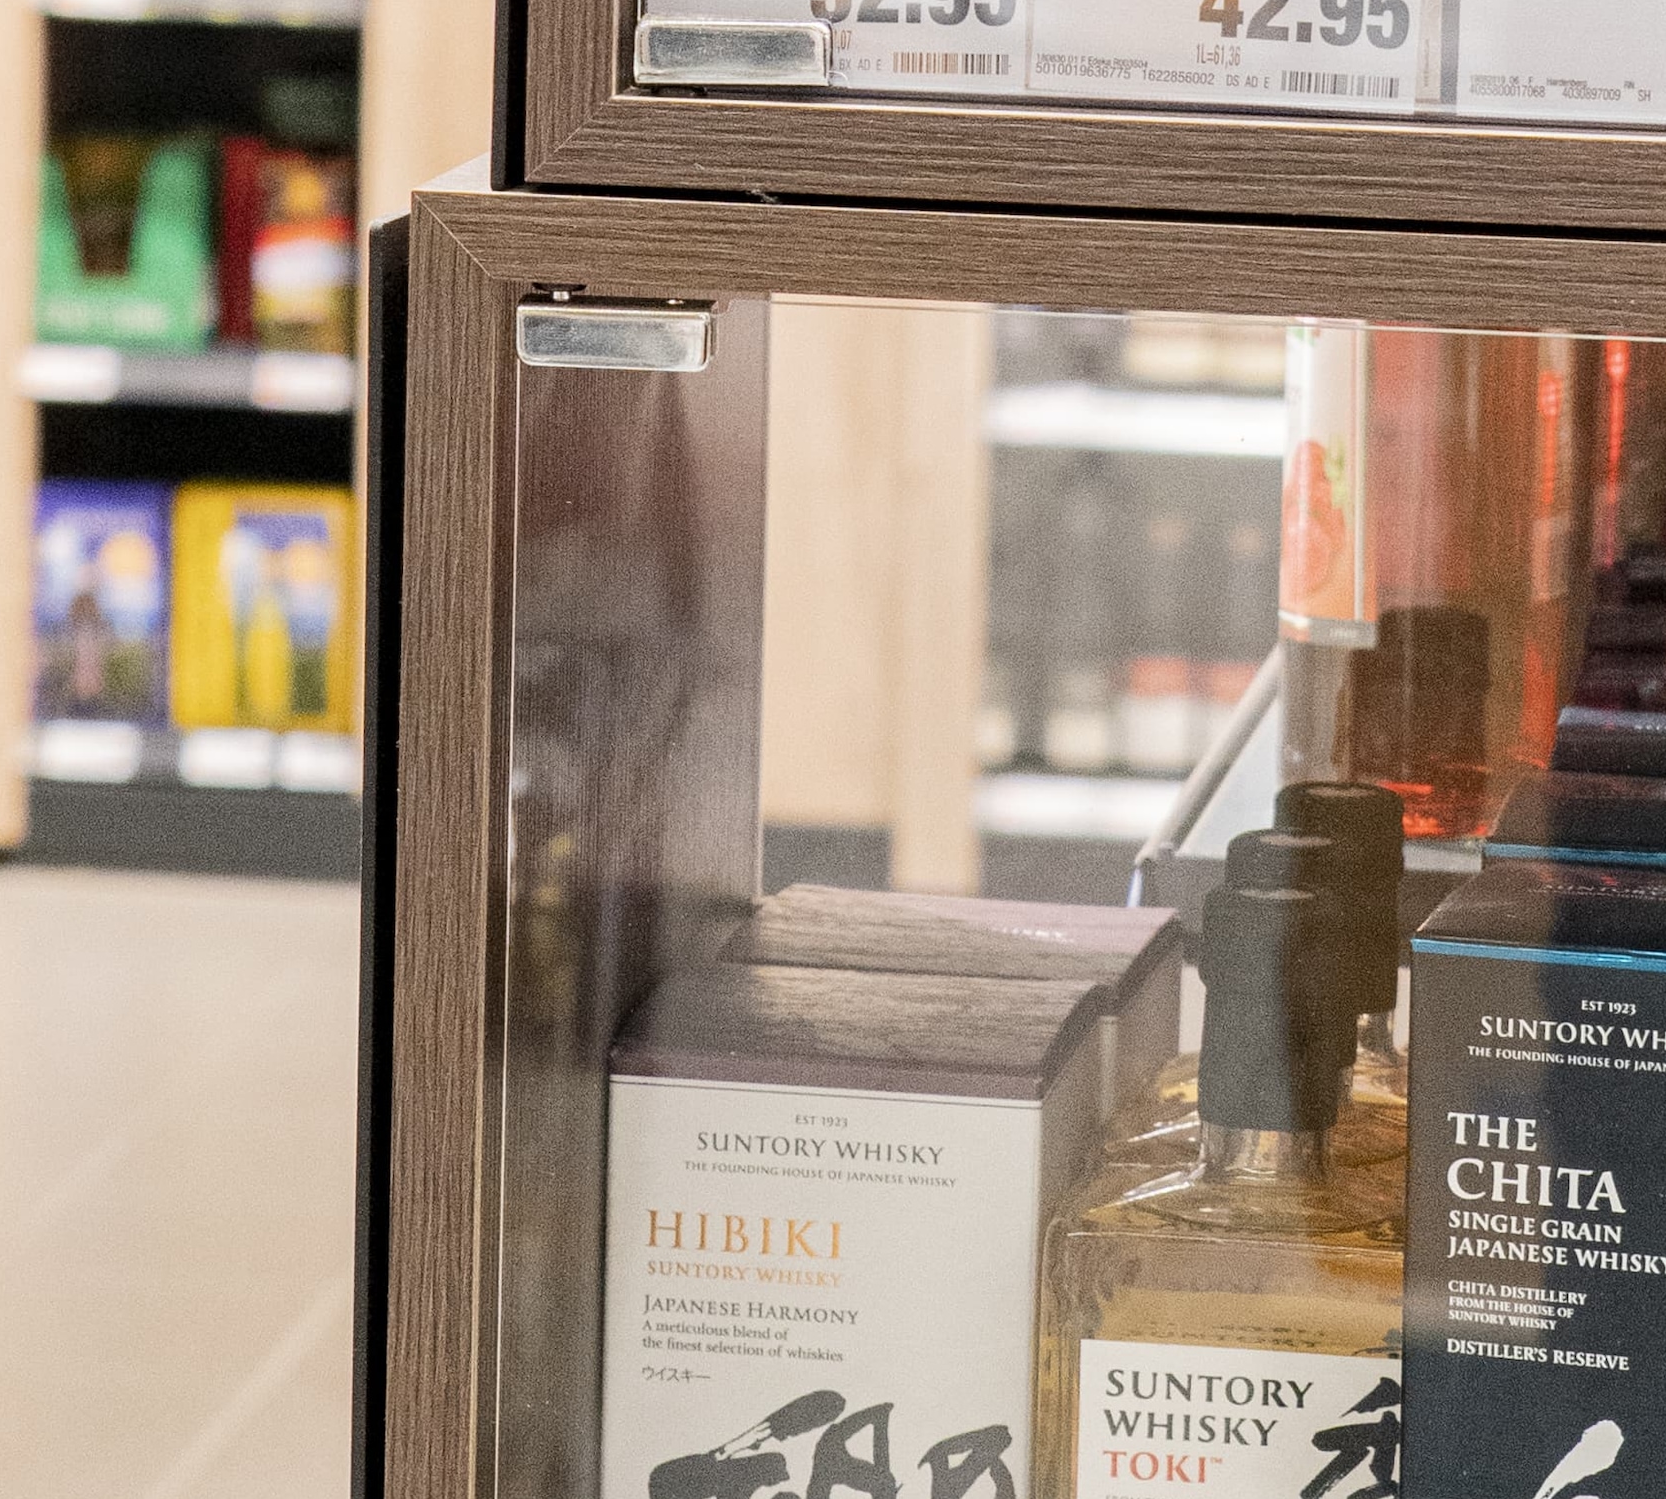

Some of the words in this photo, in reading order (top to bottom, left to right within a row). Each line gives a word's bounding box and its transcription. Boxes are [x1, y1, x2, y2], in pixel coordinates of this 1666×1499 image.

[1480, 1015, 1614, 1047] SUNTORY
[697, 1131, 827, 1158] SUNTORY
[835, 1140, 944, 1166] WHISKY
[1447, 1111, 1537, 1152] THE
[1446, 1157, 1626, 1214] CHITA
[647, 1209, 843, 1259] HIBIKI
[1449, 1210, 1535, 1236] SINGLE
[1541, 1219, 1622, 1244] GRAIN
[1448, 1236, 1568, 1265] JAPANESE
[1553, 1350, 1629, 1371] RESERVE
[1106, 1369, 1314, 1408] SUNTORY
[1104, 1409, 1278, 1447] WHISKY
